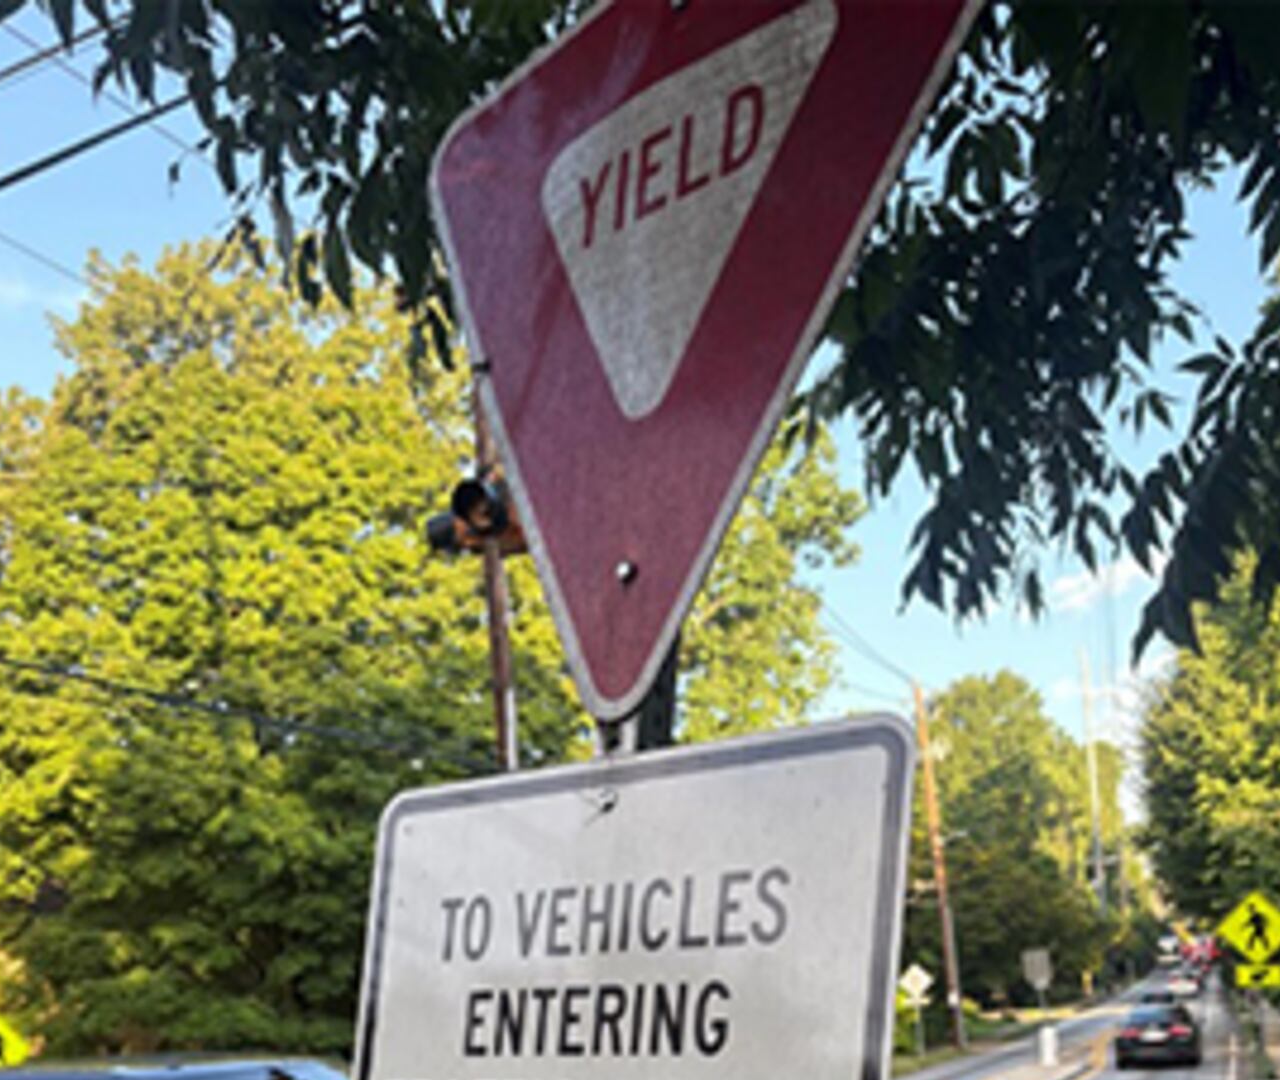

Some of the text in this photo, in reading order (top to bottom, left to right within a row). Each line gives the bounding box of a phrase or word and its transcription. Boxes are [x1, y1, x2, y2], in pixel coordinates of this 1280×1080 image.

[579, 82, 764, 248] YIELD
[441, 867, 791, 962] TO VEHICLES
[463, 980, 731, 1057] ENTERING
